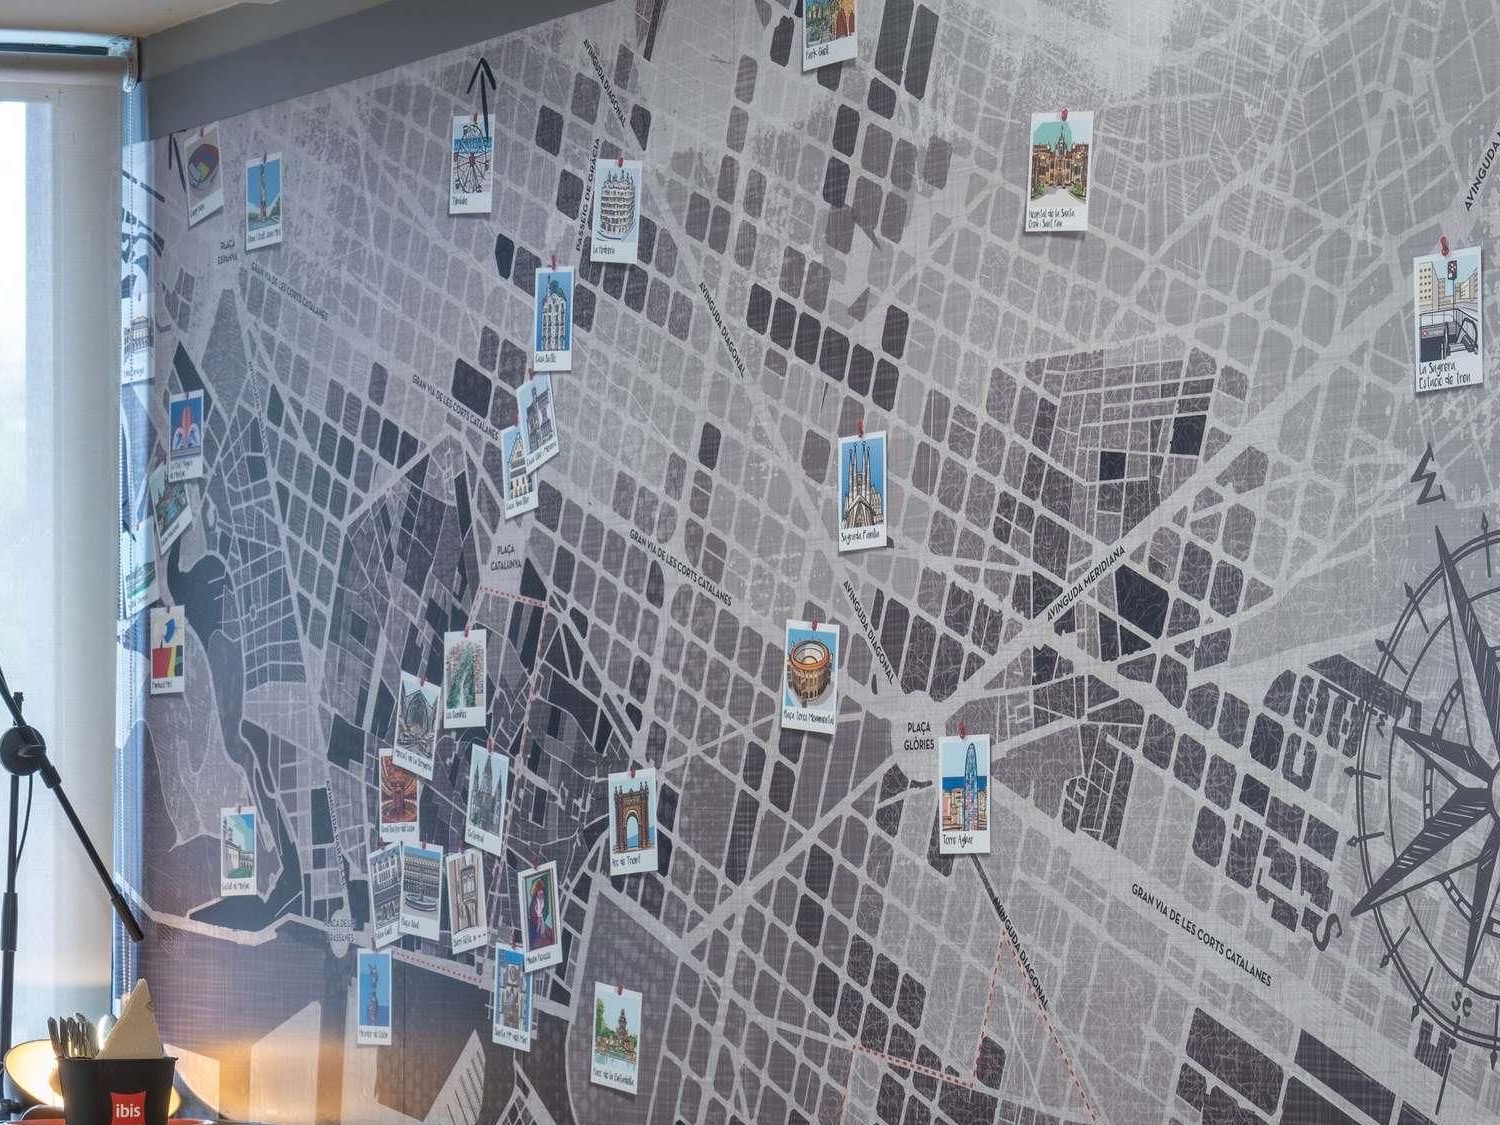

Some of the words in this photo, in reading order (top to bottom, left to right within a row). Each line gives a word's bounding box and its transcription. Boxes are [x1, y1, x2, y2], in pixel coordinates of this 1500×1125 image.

[583, 39, 605, 84] AVINGUDA
[603, 81, 626, 128] DIAGONAL
[1465, 140, 1500, 212] AVINGUDA
[576, 203, 589, 252] PASSEIG
[584, 184, 592, 201] DE
[699, 282, 722, 329] AVINGUDA
[720, 326, 746, 378] DIAGONAL
[490, 559, 522, 571] CATALUNYA
[497, 544, 515, 556] PLAÇA
[629, 529, 646, 547] GRAN
[647, 540, 656, 555] VIA
[658, 548, 665, 561] DE
[666, 555, 677, 569] LES
[677, 562, 698, 583] CORTS
[698, 576, 732, 607] CATALANES
[1047, 583, 1083, 622] AVINGUDA
[1083, 545, 1125, 588] MERIDIANA
[843, 580, 869, 632] AVINGUDA
[867, 629, 895, 685] DIAGONAL
[904, 737, 935, 751] GLÒRIES
[907, 721, 932, 736] PLAÇA
[993, 896, 1020, 953] AVINGUDA
[1019, 950, 1049, 1011] DIAGONAL
[1132, 884, 1155, 905] GRAN
[1155, 898, 1168, 918] VIA
[1169, 909, 1180, 926] DE
[1181, 917, 1196, 936] LES
[1197, 929, 1225, 956] CORTS
[1225, 949, 1272, 987] CATALANES
[115, 1103, 141, 1118] ibis
